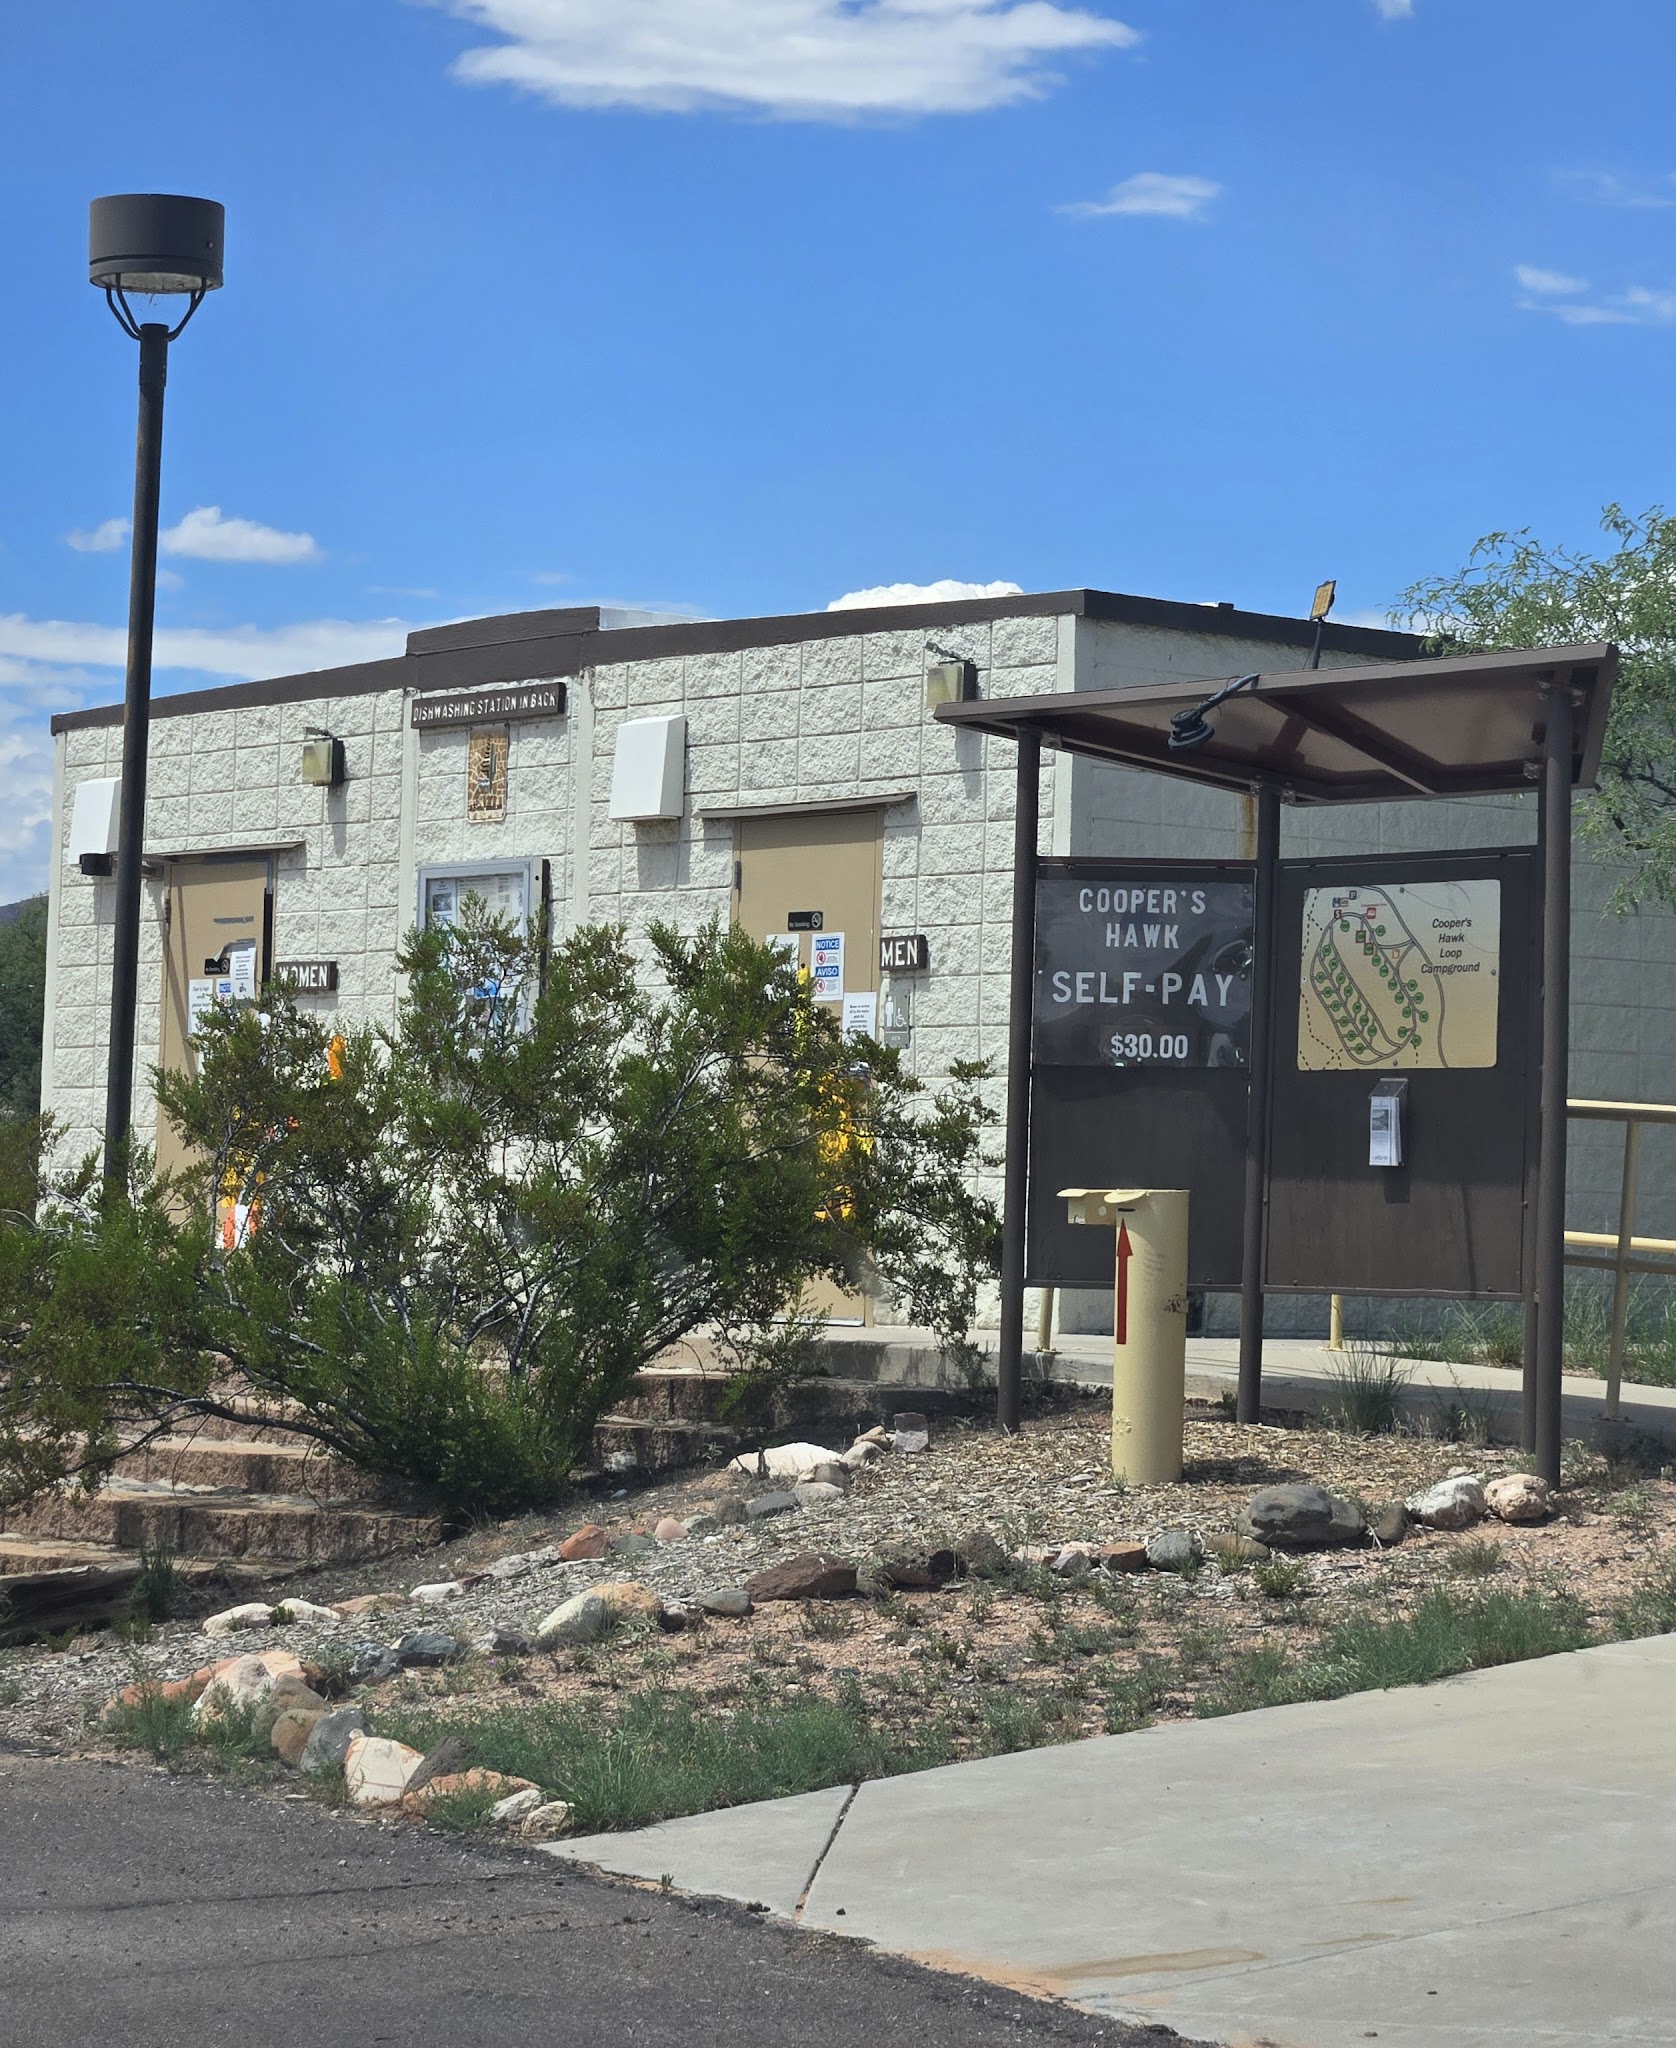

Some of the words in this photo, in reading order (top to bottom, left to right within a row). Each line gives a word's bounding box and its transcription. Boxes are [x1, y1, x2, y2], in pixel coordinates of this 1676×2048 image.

[413, 701, 475, 721] DISHWASHING
[477, 696, 516, 714] STATION
[519, 694, 529, 709] IN
[530, 692, 556, 708] BACK
[1079, 888, 1207, 914] COOPER'S
[1432, 917, 1472, 931] Cooper's
[816, 939, 839, 949] NOTICE
[1105, 922, 1180, 949] HAWK
[1438, 932, 1465, 943] Hawk
[881, 939, 918, 967] MEN
[1439, 948, 1463, 961] Loop
[816, 967, 838, 976] AVISO
[1420, 962, 1480, 977] Campground
[1052, 971, 1234, 1007] SELF-PAY
[1110, 1032, 1189, 1059] $30.00
